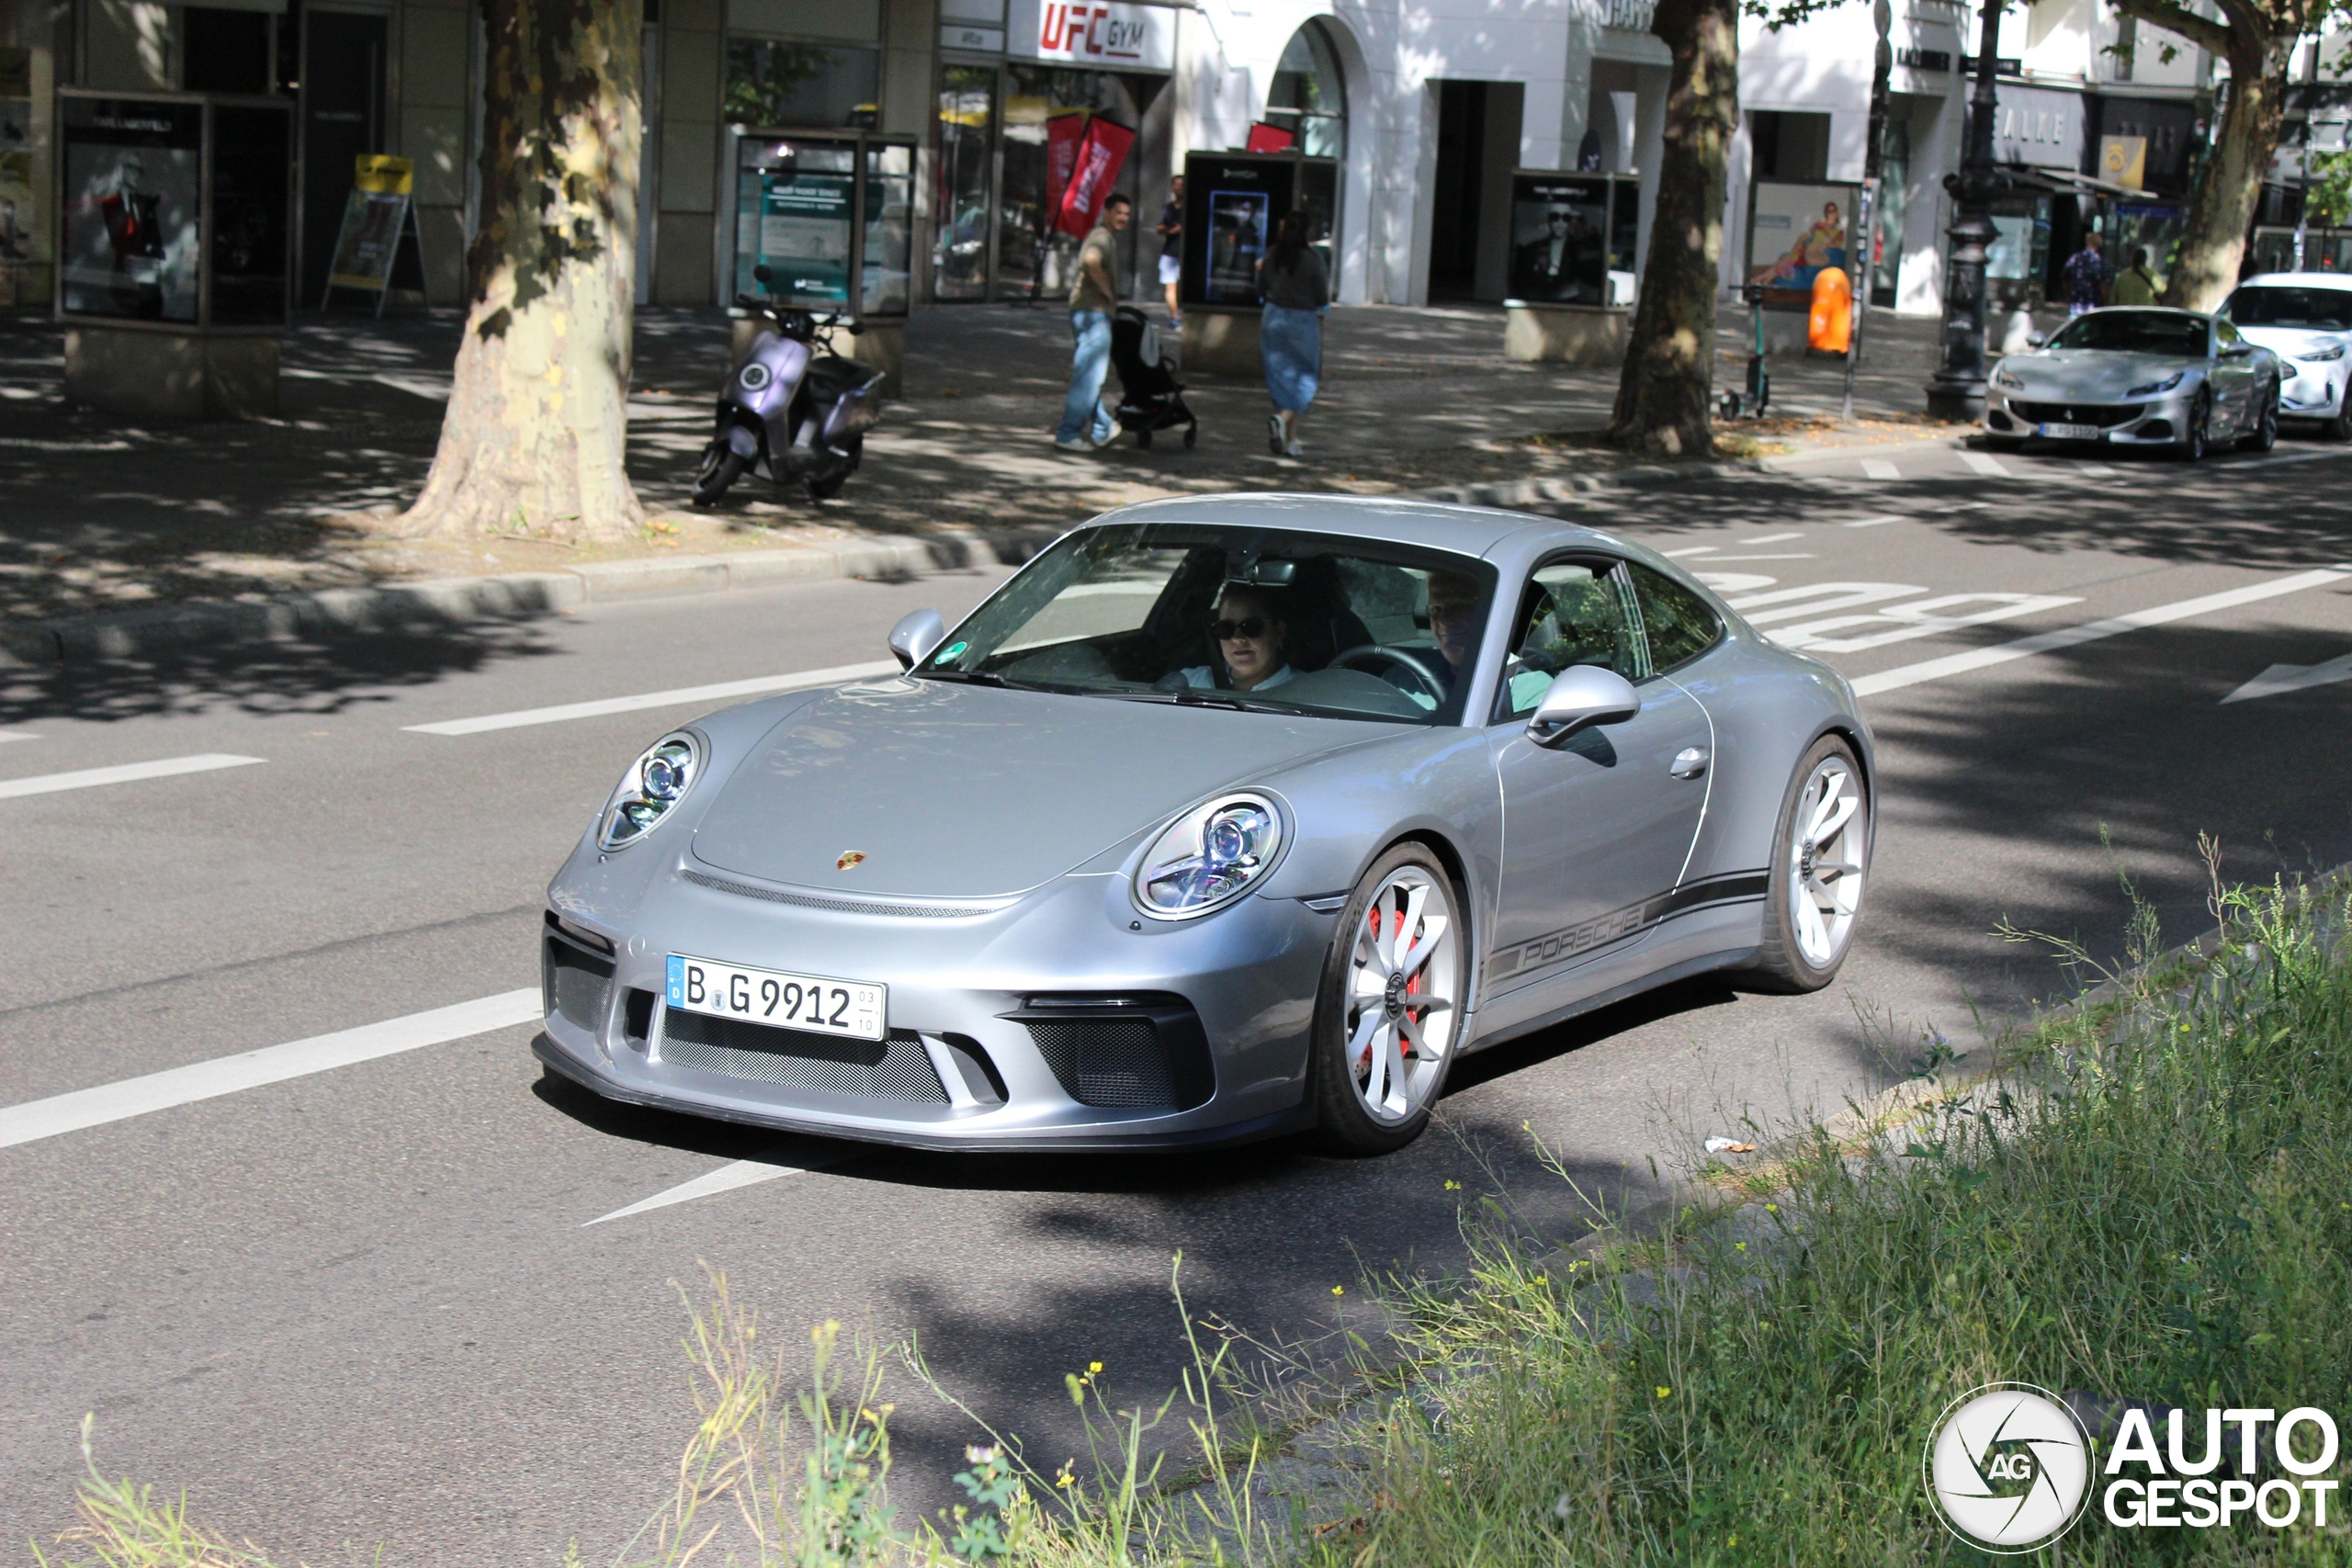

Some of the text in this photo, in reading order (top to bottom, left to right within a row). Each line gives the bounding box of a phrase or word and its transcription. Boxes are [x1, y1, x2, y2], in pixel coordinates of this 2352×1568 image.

[1041, 3, 1145, 54] UFC GYM
[1993, 107, 2064, 145] ALKE
[1523, 907, 1643, 967] PORSCHE
[672, 965, 850, 1028] D B G 9912
[859, 990, 874, 1002] 03
[859, 1019, 873, 1031] 10
